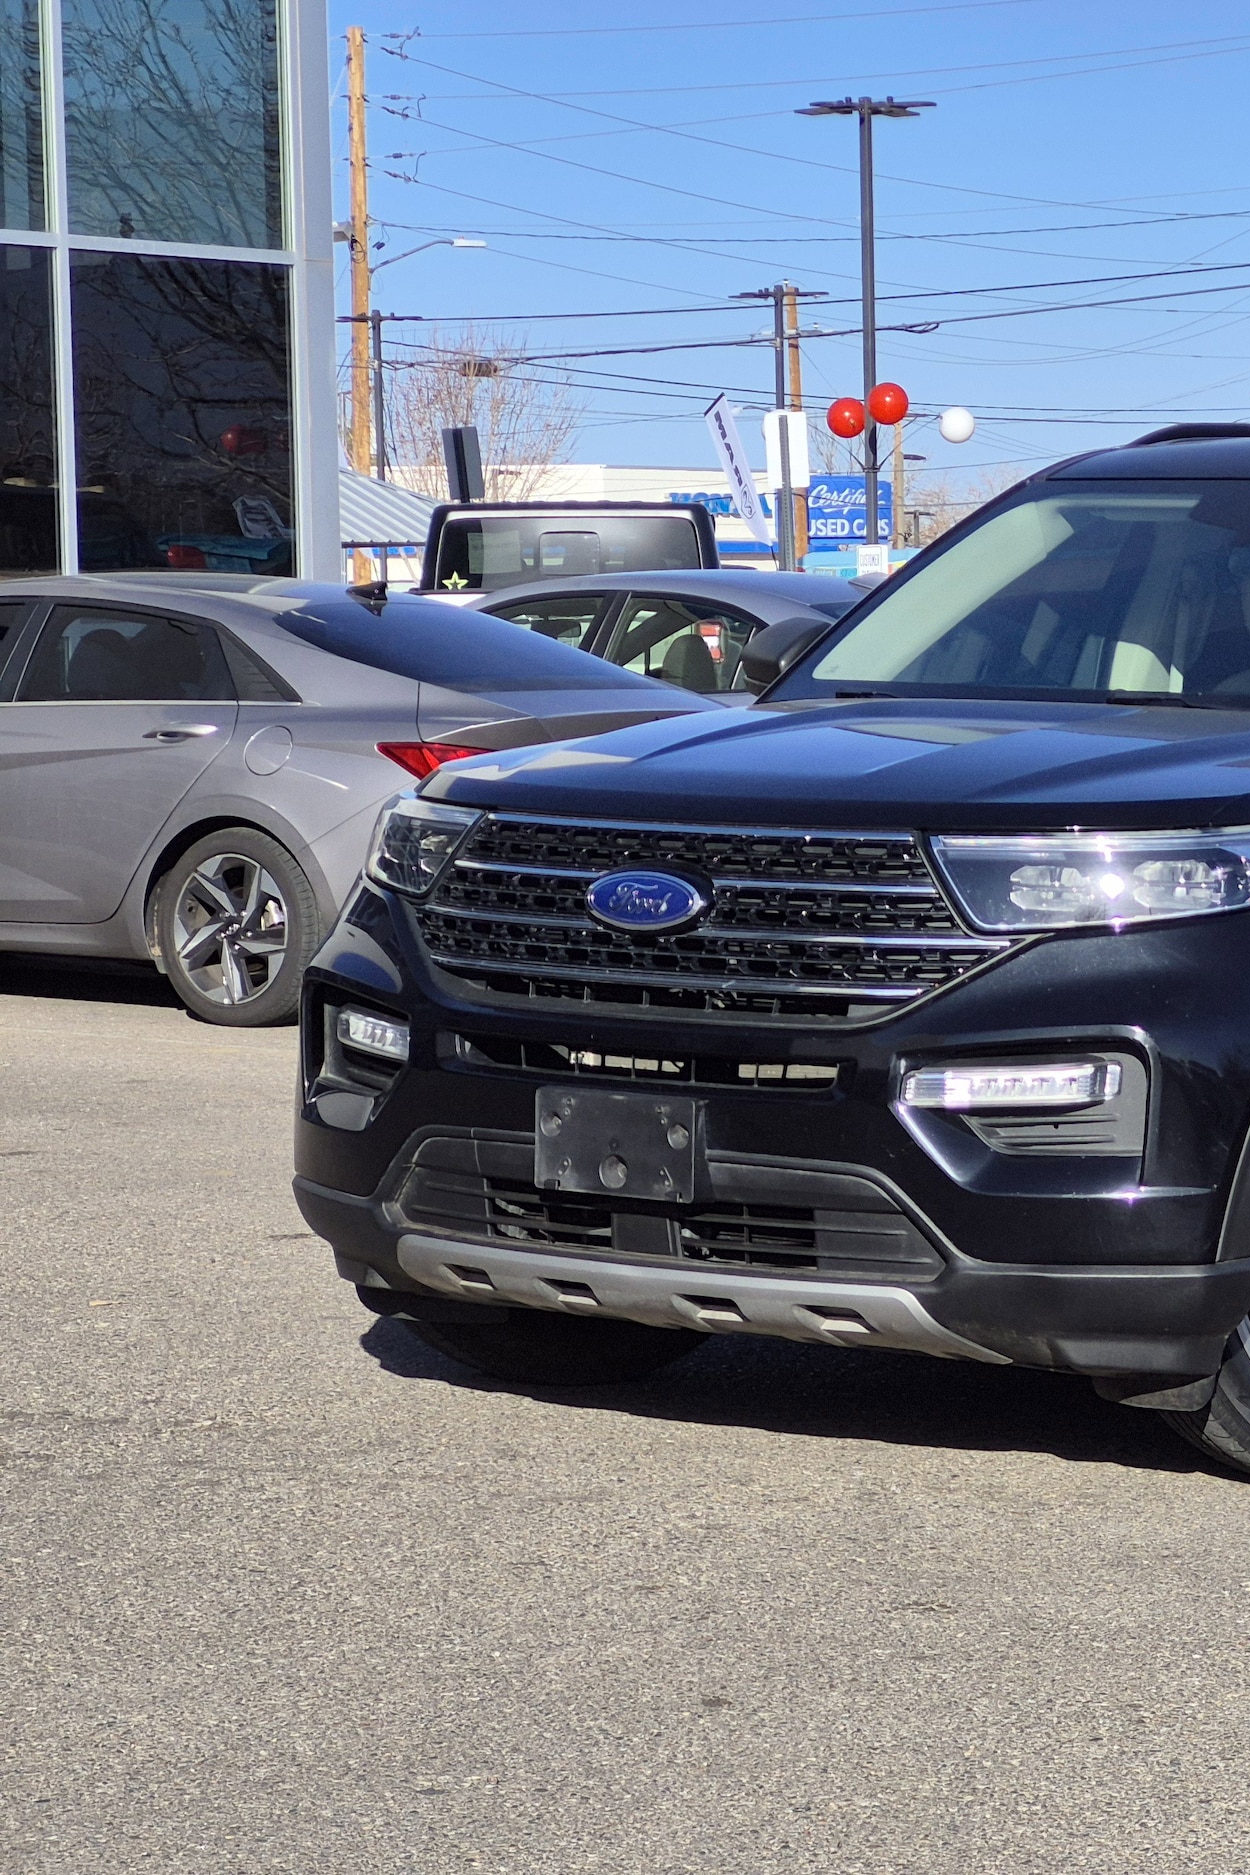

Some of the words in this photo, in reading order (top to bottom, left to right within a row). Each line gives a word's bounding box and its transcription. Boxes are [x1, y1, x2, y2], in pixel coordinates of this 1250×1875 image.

[808, 485, 886, 515] Certifi
[853, 518, 889, 536] CS
[608, 882, 672, 915] Ford
